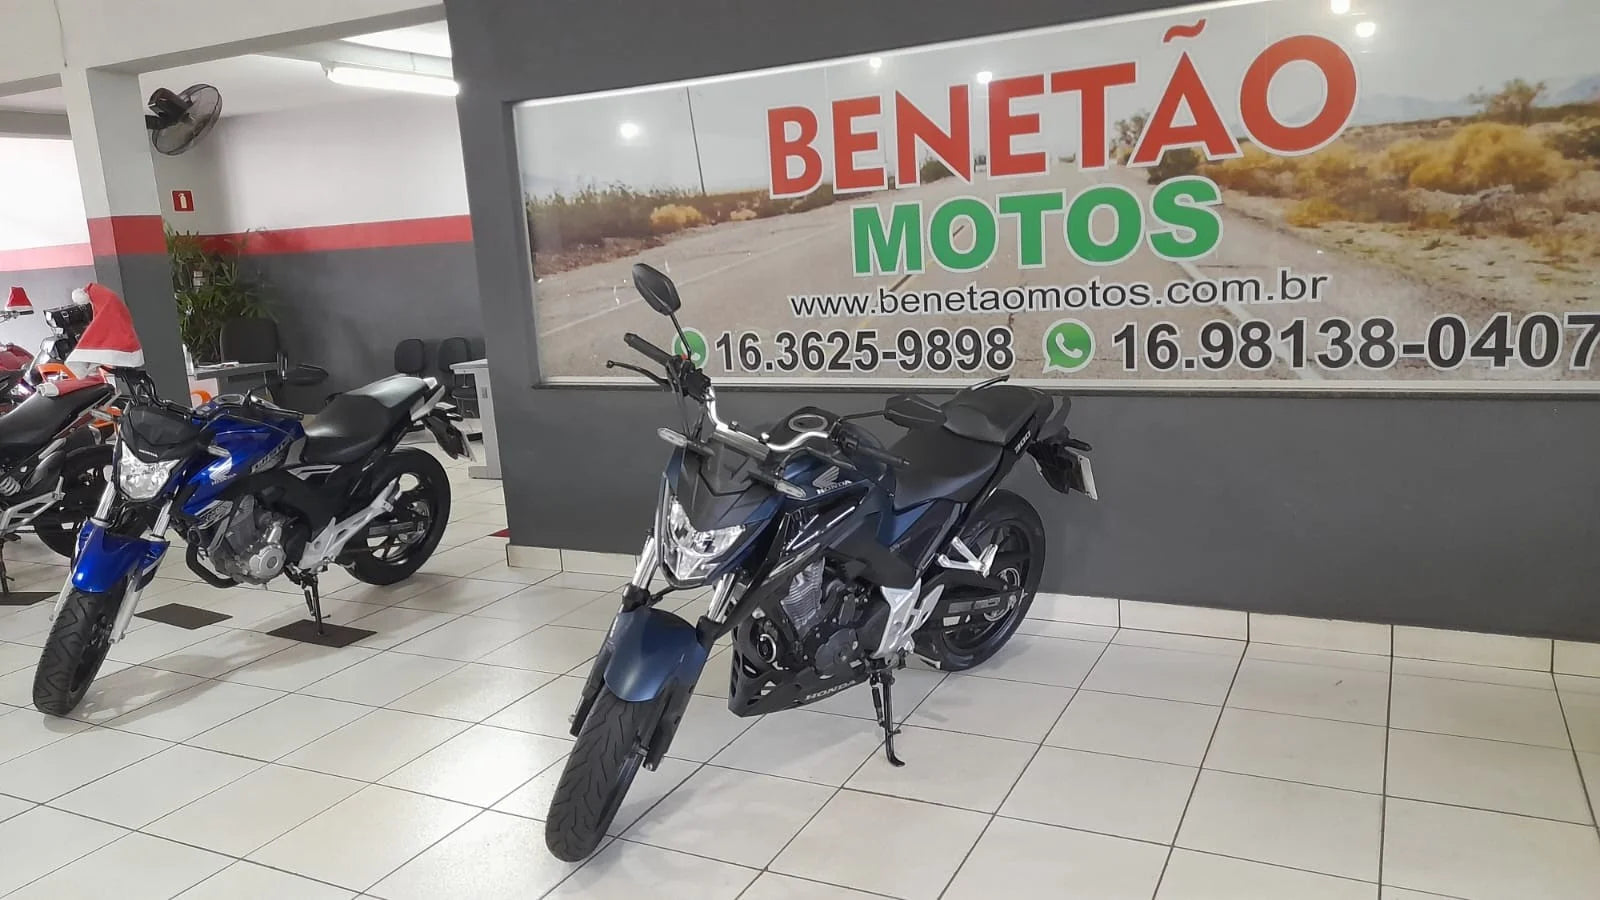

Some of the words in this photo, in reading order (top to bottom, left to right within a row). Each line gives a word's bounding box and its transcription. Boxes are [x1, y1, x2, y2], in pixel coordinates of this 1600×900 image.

[768, 22, 1356, 195] BENETÃO
[853, 178, 1221, 275] MOTOS
[790, 270, 1328, 317] www.benetaomotos.com.br
[715, 326, 1015, 372] 16.3625-9898
[1112, 313, 1600, 370] 16.98138-0407
[816, 479, 852, 495] HONDA
[805, 680, 856, 700] HONDA
